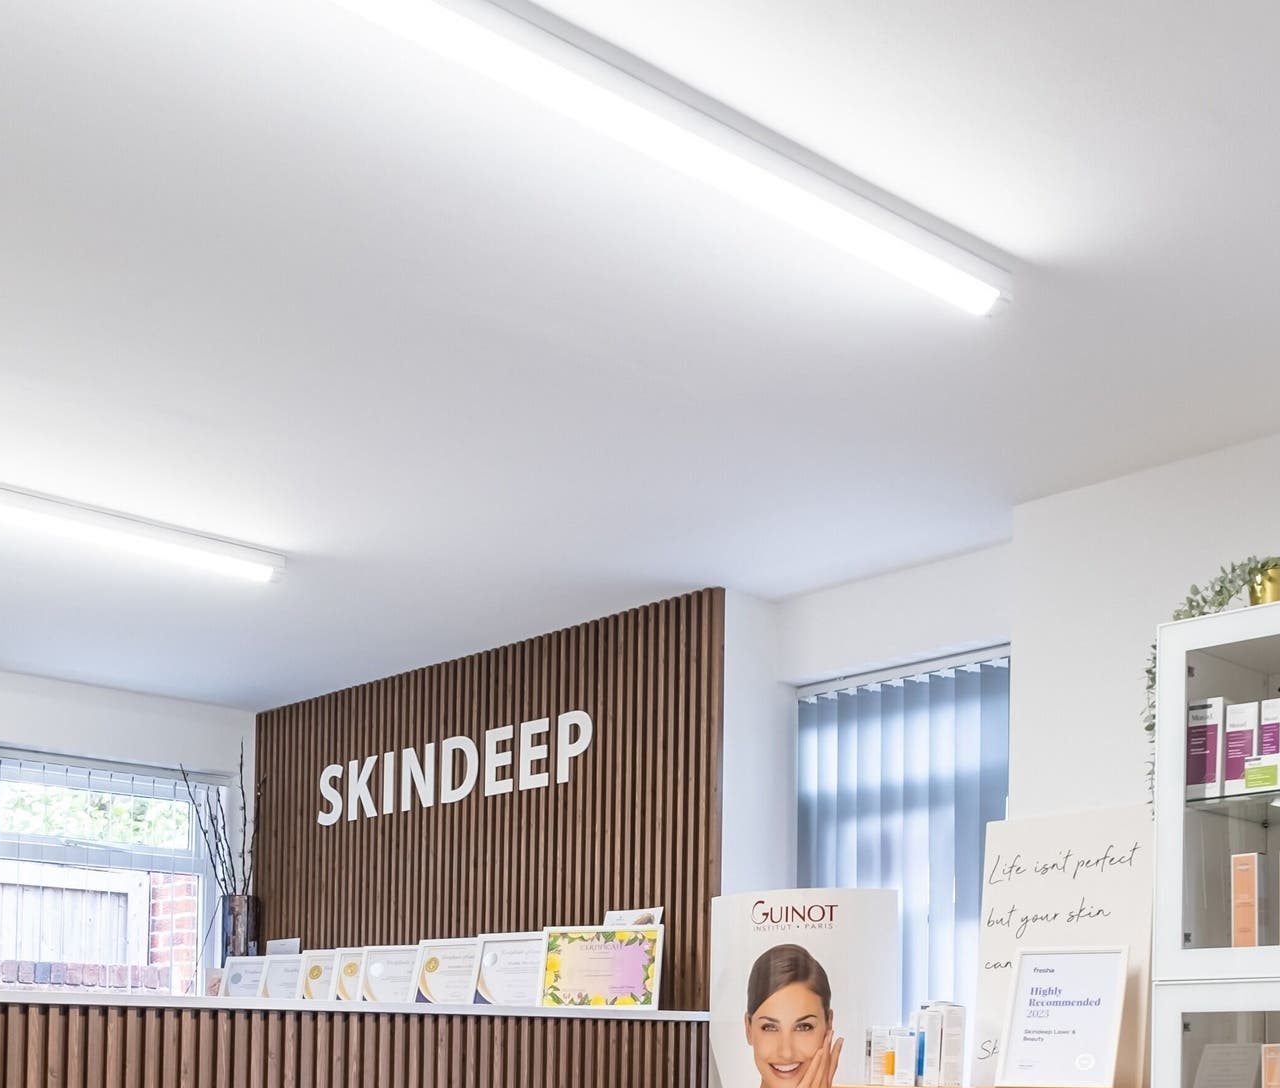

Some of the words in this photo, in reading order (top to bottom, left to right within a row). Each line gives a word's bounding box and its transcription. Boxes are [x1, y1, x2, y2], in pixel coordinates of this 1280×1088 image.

[317, 709, 593, 826] SKINDEEP
[988, 854, 1027, 885] Life
[1034, 849, 1073, 876] isn't
[1073, 841, 1142, 880] perfect
[751, 900, 839, 925] GUINOT
[986, 904, 1017, 929] but
[1015, 910, 1060, 940] your
[1066, 896, 1113, 925] skin
[753, 924, 792, 932] INSTITUT
[804, 922, 834, 930] PARIS
[984, 959, 1013, 971] can
[1030, 986, 1063, 997] Highly
[1028, 998, 1102, 1007] Recommended
